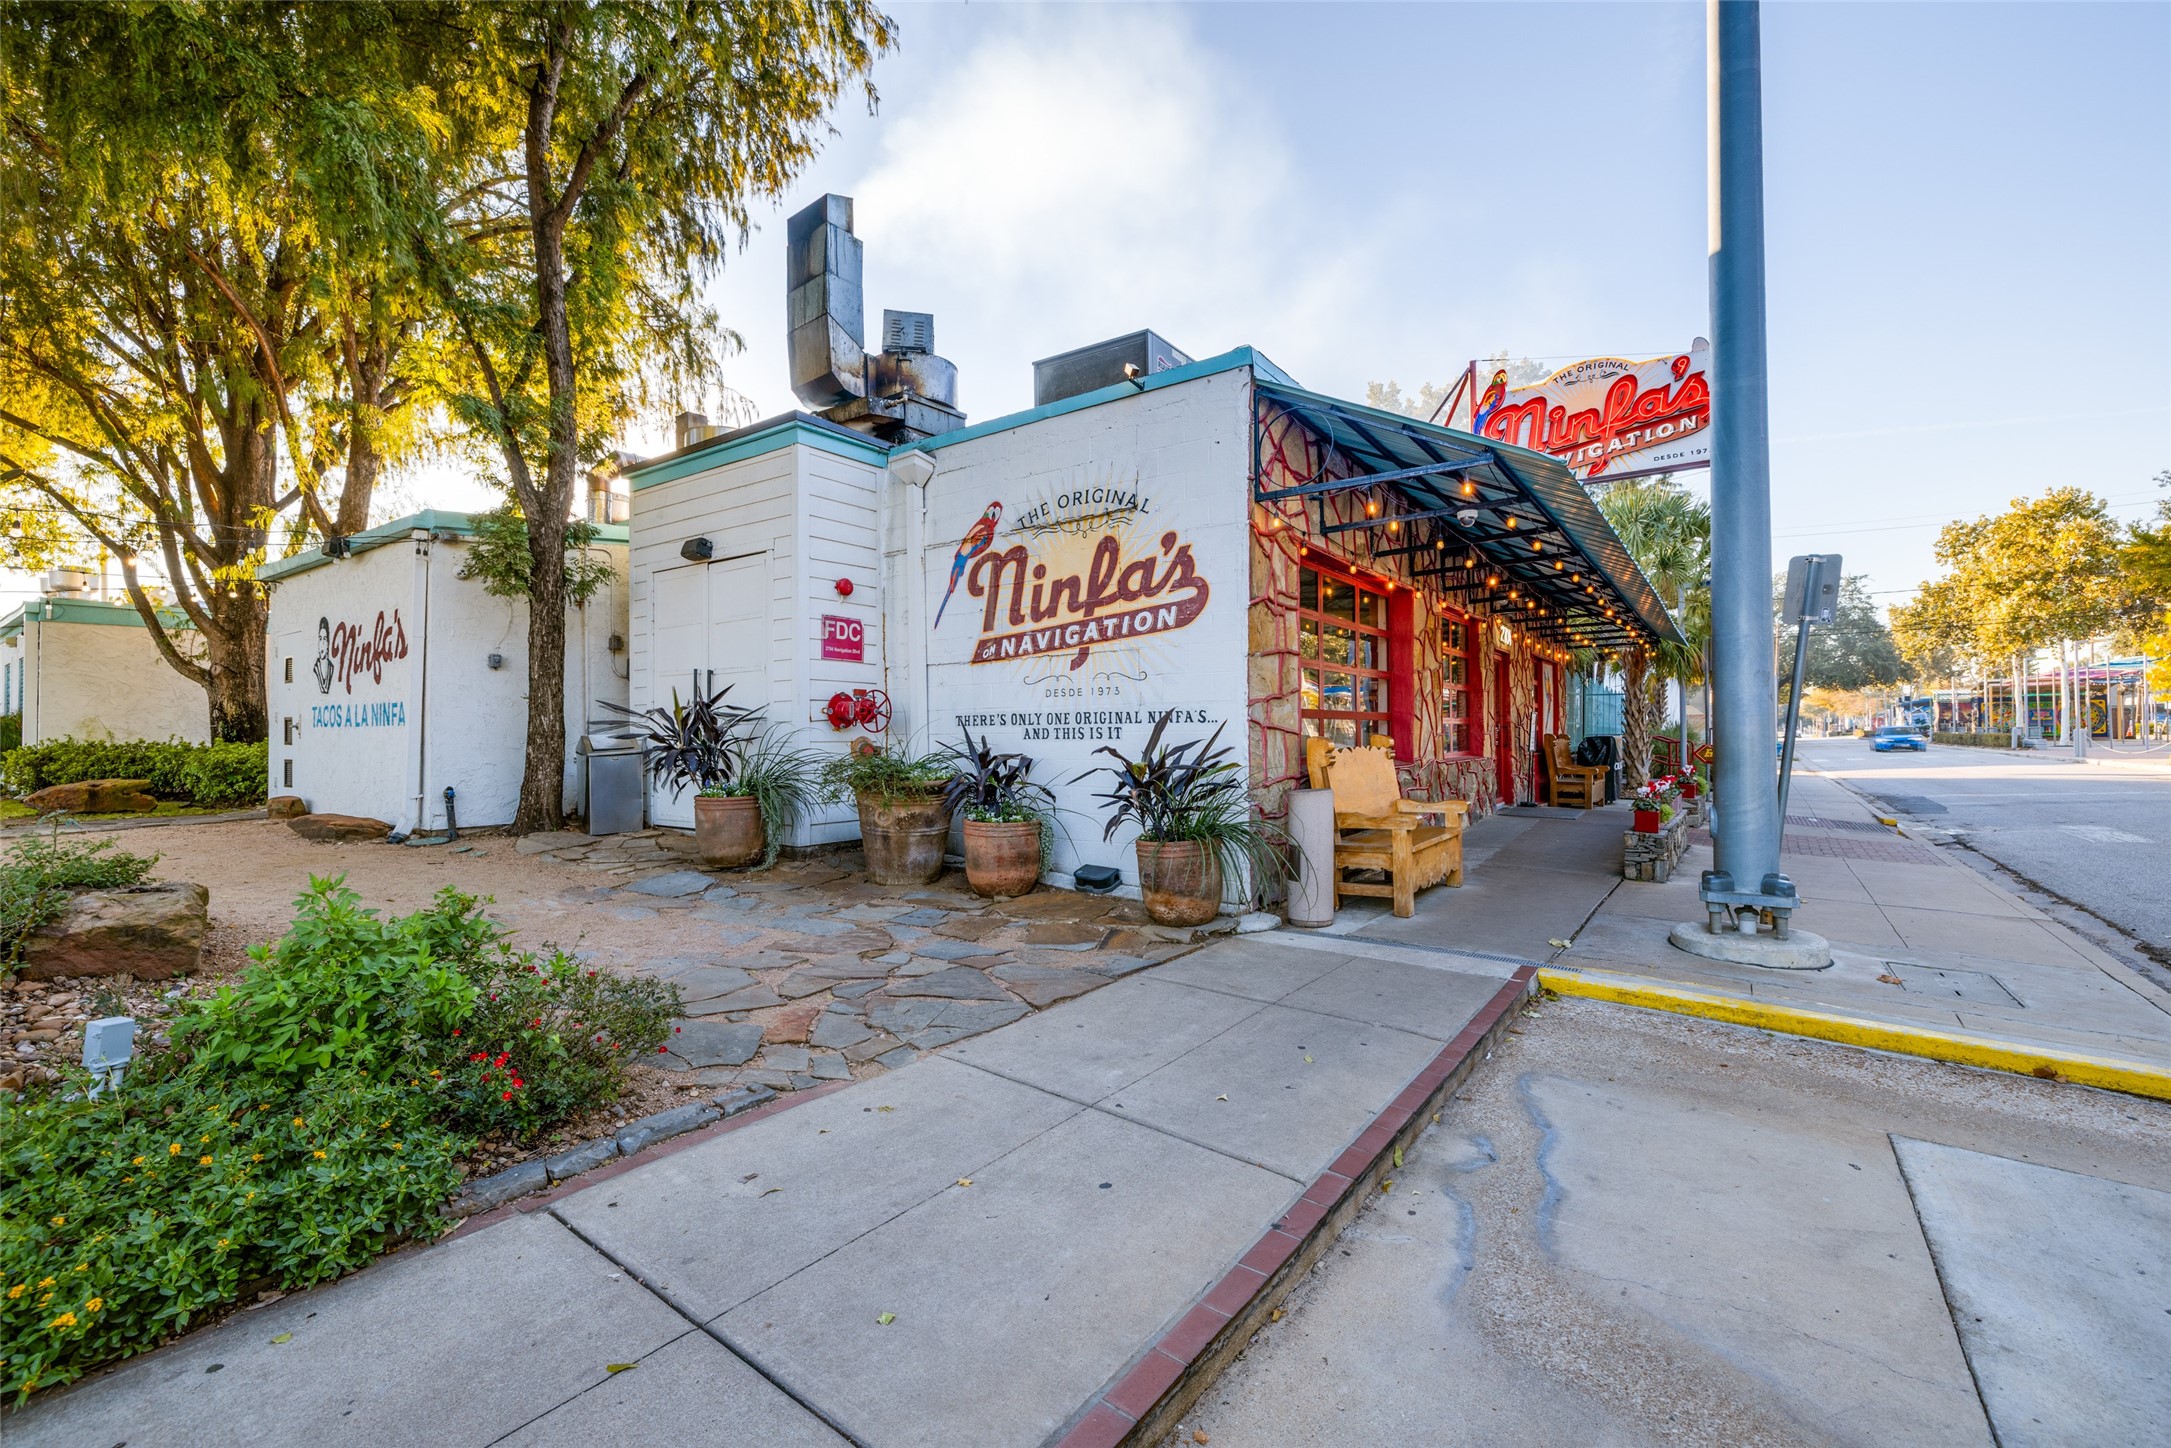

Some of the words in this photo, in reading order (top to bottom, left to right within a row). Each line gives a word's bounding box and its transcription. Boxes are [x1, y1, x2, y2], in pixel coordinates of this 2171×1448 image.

[1552, 369, 1573, 384] THE
[1577, 361, 1629, 373] ORIGINAL
[1483, 355, 1710, 477] Ninfa's
[1559, 414, 1698, 464] VIGATION
[1653, 451, 1685, 462] DESDE
[1017, 502, 1050, 529] THE
[1057, 488, 1150, 515] ORIGINAL
[967, 530, 1197, 671] Ninfa's
[824, 620, 861, 642] FDC
[982, 643, 997, 659] ON
[1000, 605, 1177, 657] NAVIGATION
[331, 608, 408, 695] Ninfa's
[1045, 688, 1083, 698] DESDE
[1090, 687, 1121, 696] 1973
[312, 704, 342, 728] TACOS
[344, 704, 352, 727] A
[354, 704, 368, 727] LA
[371, 702, 405, 727] NINFA
[955, 714, 1007, 727] THERE'S
[1011, 713, 1042, 726] ONLY
[1046, 712, 1071, 725] ONE
[1075, 711, 1142, 725] ORIGINAL
[1023, 727, 1050, 740] AND
[1053, 727, 1085, 740] THIS
[1089, 727, 1103, 740] IS
[1107, 727, 1122, 740] IT
